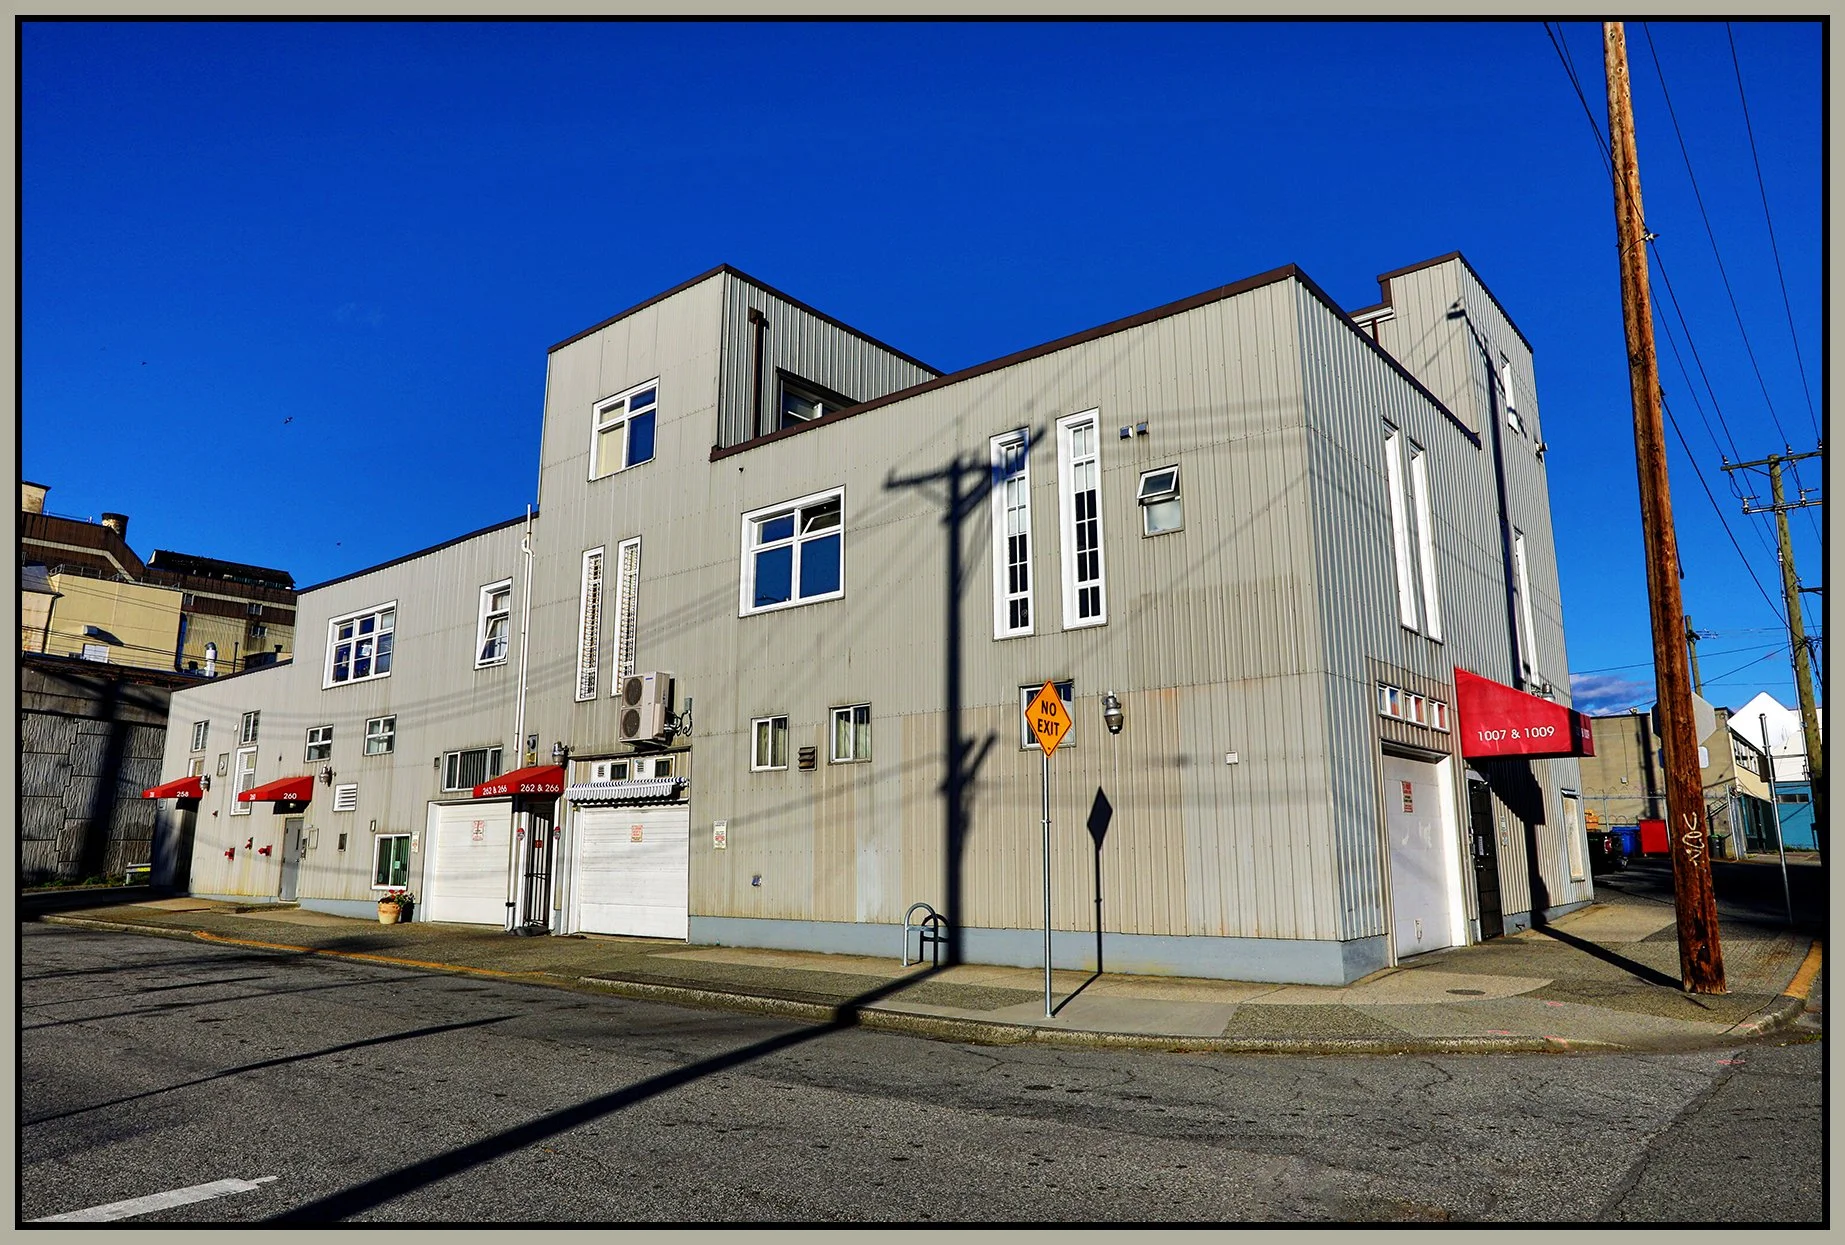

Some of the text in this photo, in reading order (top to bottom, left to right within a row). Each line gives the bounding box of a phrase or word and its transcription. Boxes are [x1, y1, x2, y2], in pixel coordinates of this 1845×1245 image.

[1041, 700, 1057, 717] NO
[1037, 718, 1060, 736] EXIT
[1478, 725, 1555, 742] 1007 & 1009
[520, 783, 560, 793] 262 & 266
